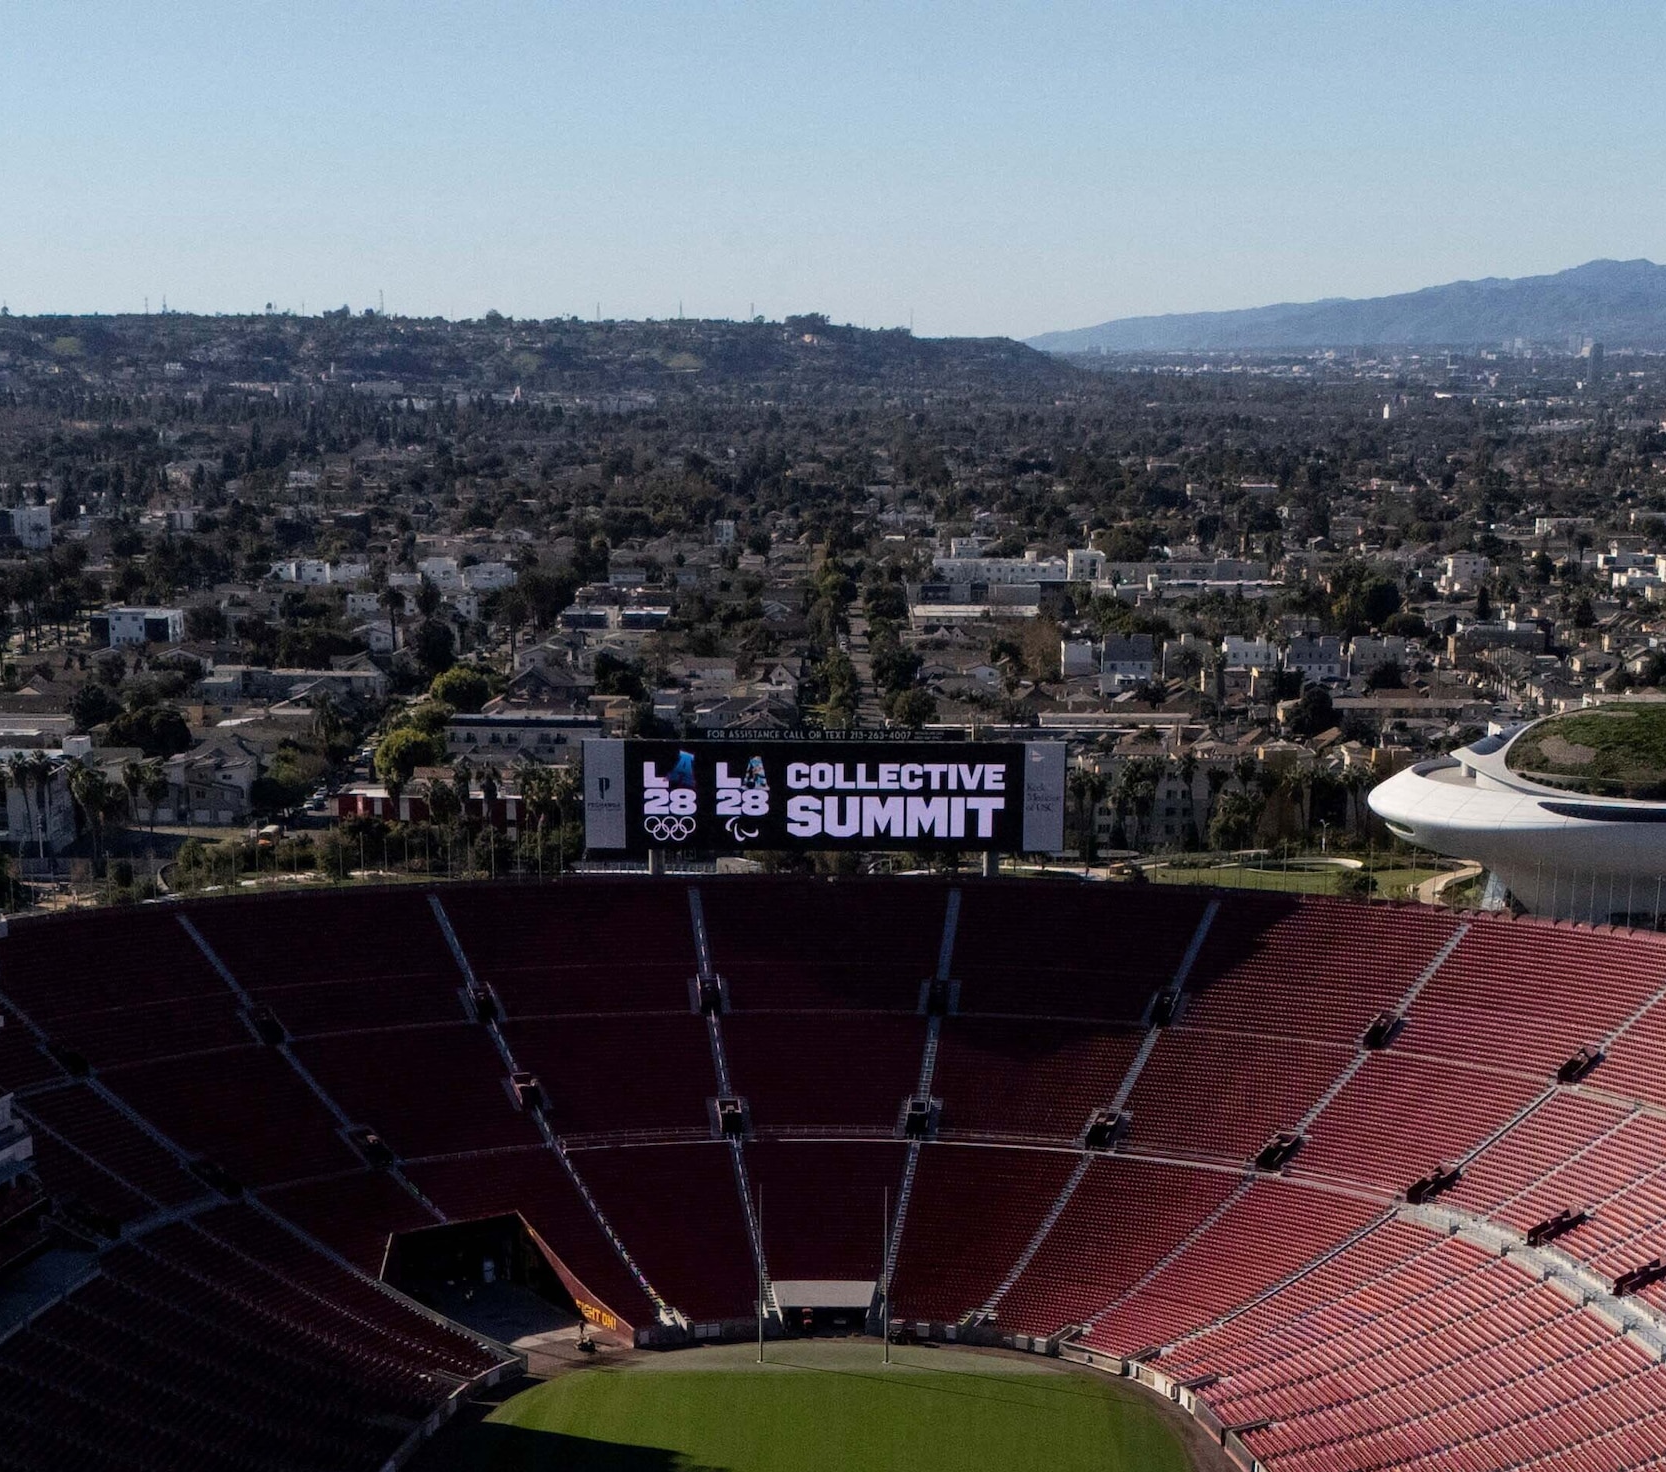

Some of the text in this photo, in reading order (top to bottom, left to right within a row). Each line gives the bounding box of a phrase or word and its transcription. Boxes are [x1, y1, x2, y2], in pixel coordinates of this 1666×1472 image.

[707, 730, 725, 739] FOR
[729, 730, 779, 739] ASSISTANCE
[783, 730, 805, 739] CALL
[808, 731, 822, 739] OR
[825, 731, 846, 740] TEXT
[850, 731, 911, 740] 213-263-4007
[643, 750, 696, 788] LA
[786, 762, 1006, 790] COLLECTIVE
[643, 788, 697, 815] 28
[715, 789, 769, 816] 28
[786, 795, 1006, 838] SUMMIT
